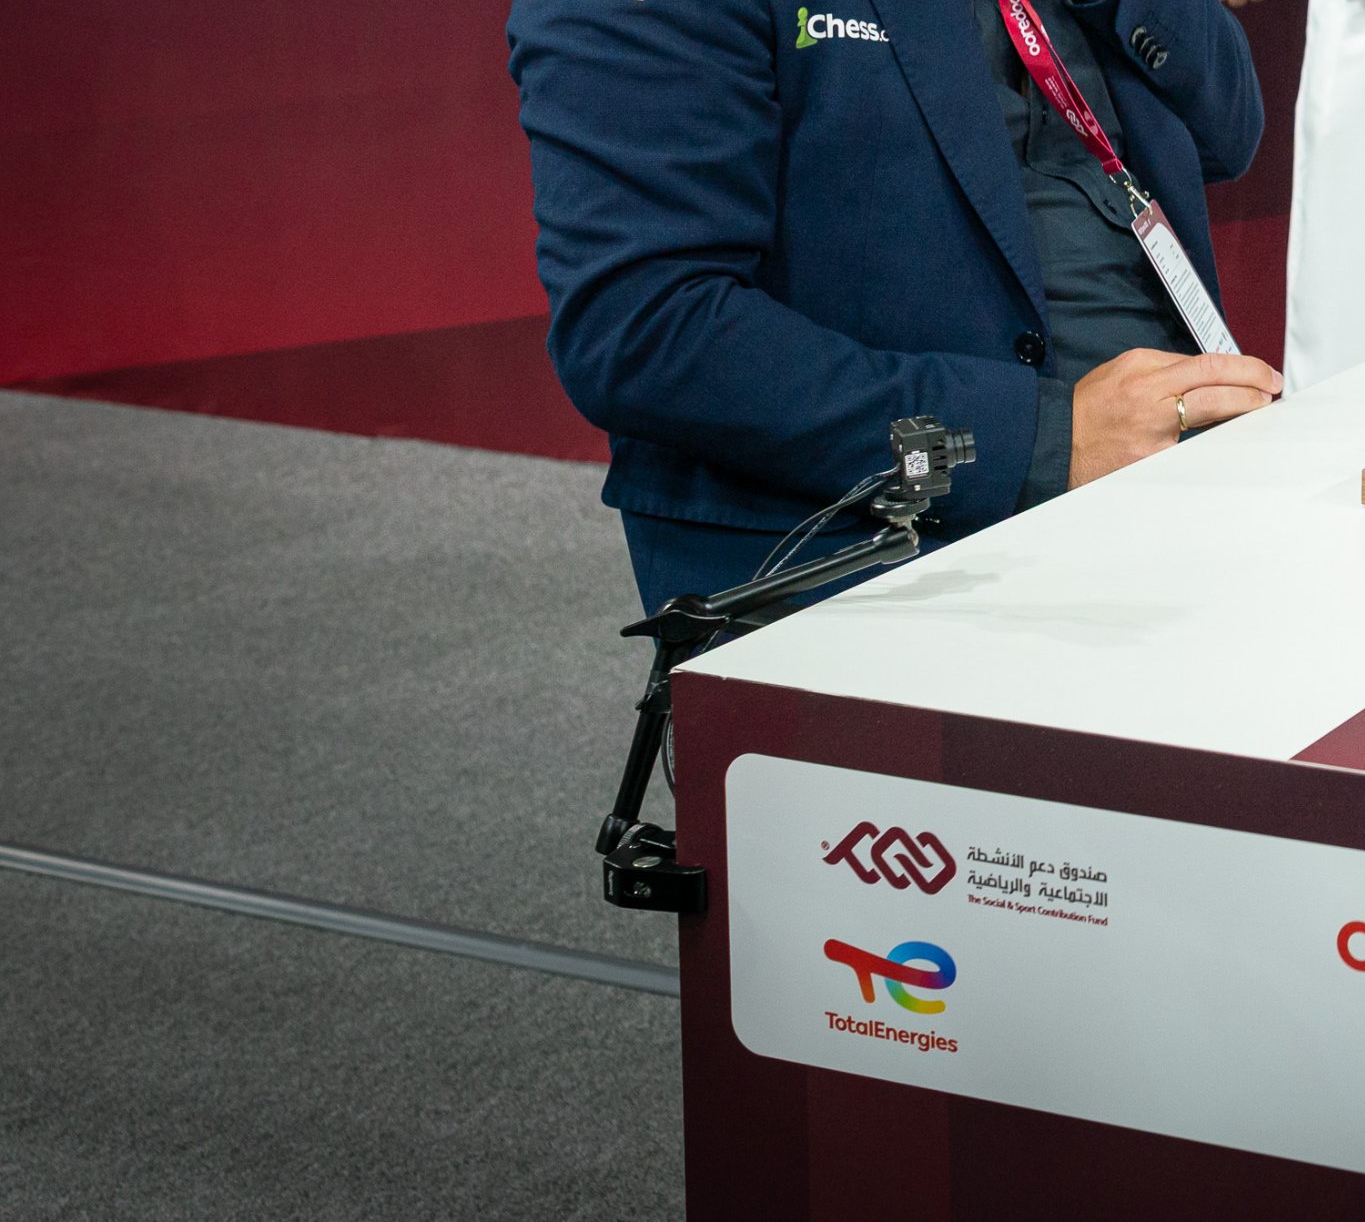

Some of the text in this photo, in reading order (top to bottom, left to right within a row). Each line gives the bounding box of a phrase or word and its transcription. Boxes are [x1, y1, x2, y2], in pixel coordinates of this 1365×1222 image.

[807, 13, 890, 43] Chess.c
[1028, 860, 1055, 878] دعم
[1059, 862, 1108, 883] صندوق
[967, 870, 1108, 908] الاجتماعية والرياضية
[982, 896, 1006, 910] Social
[1037, 906, 1087, 923] Contribution
[1088, 914, 1108, 927] Fund
[824, 1010, 959, 1054] TotalEnergies
